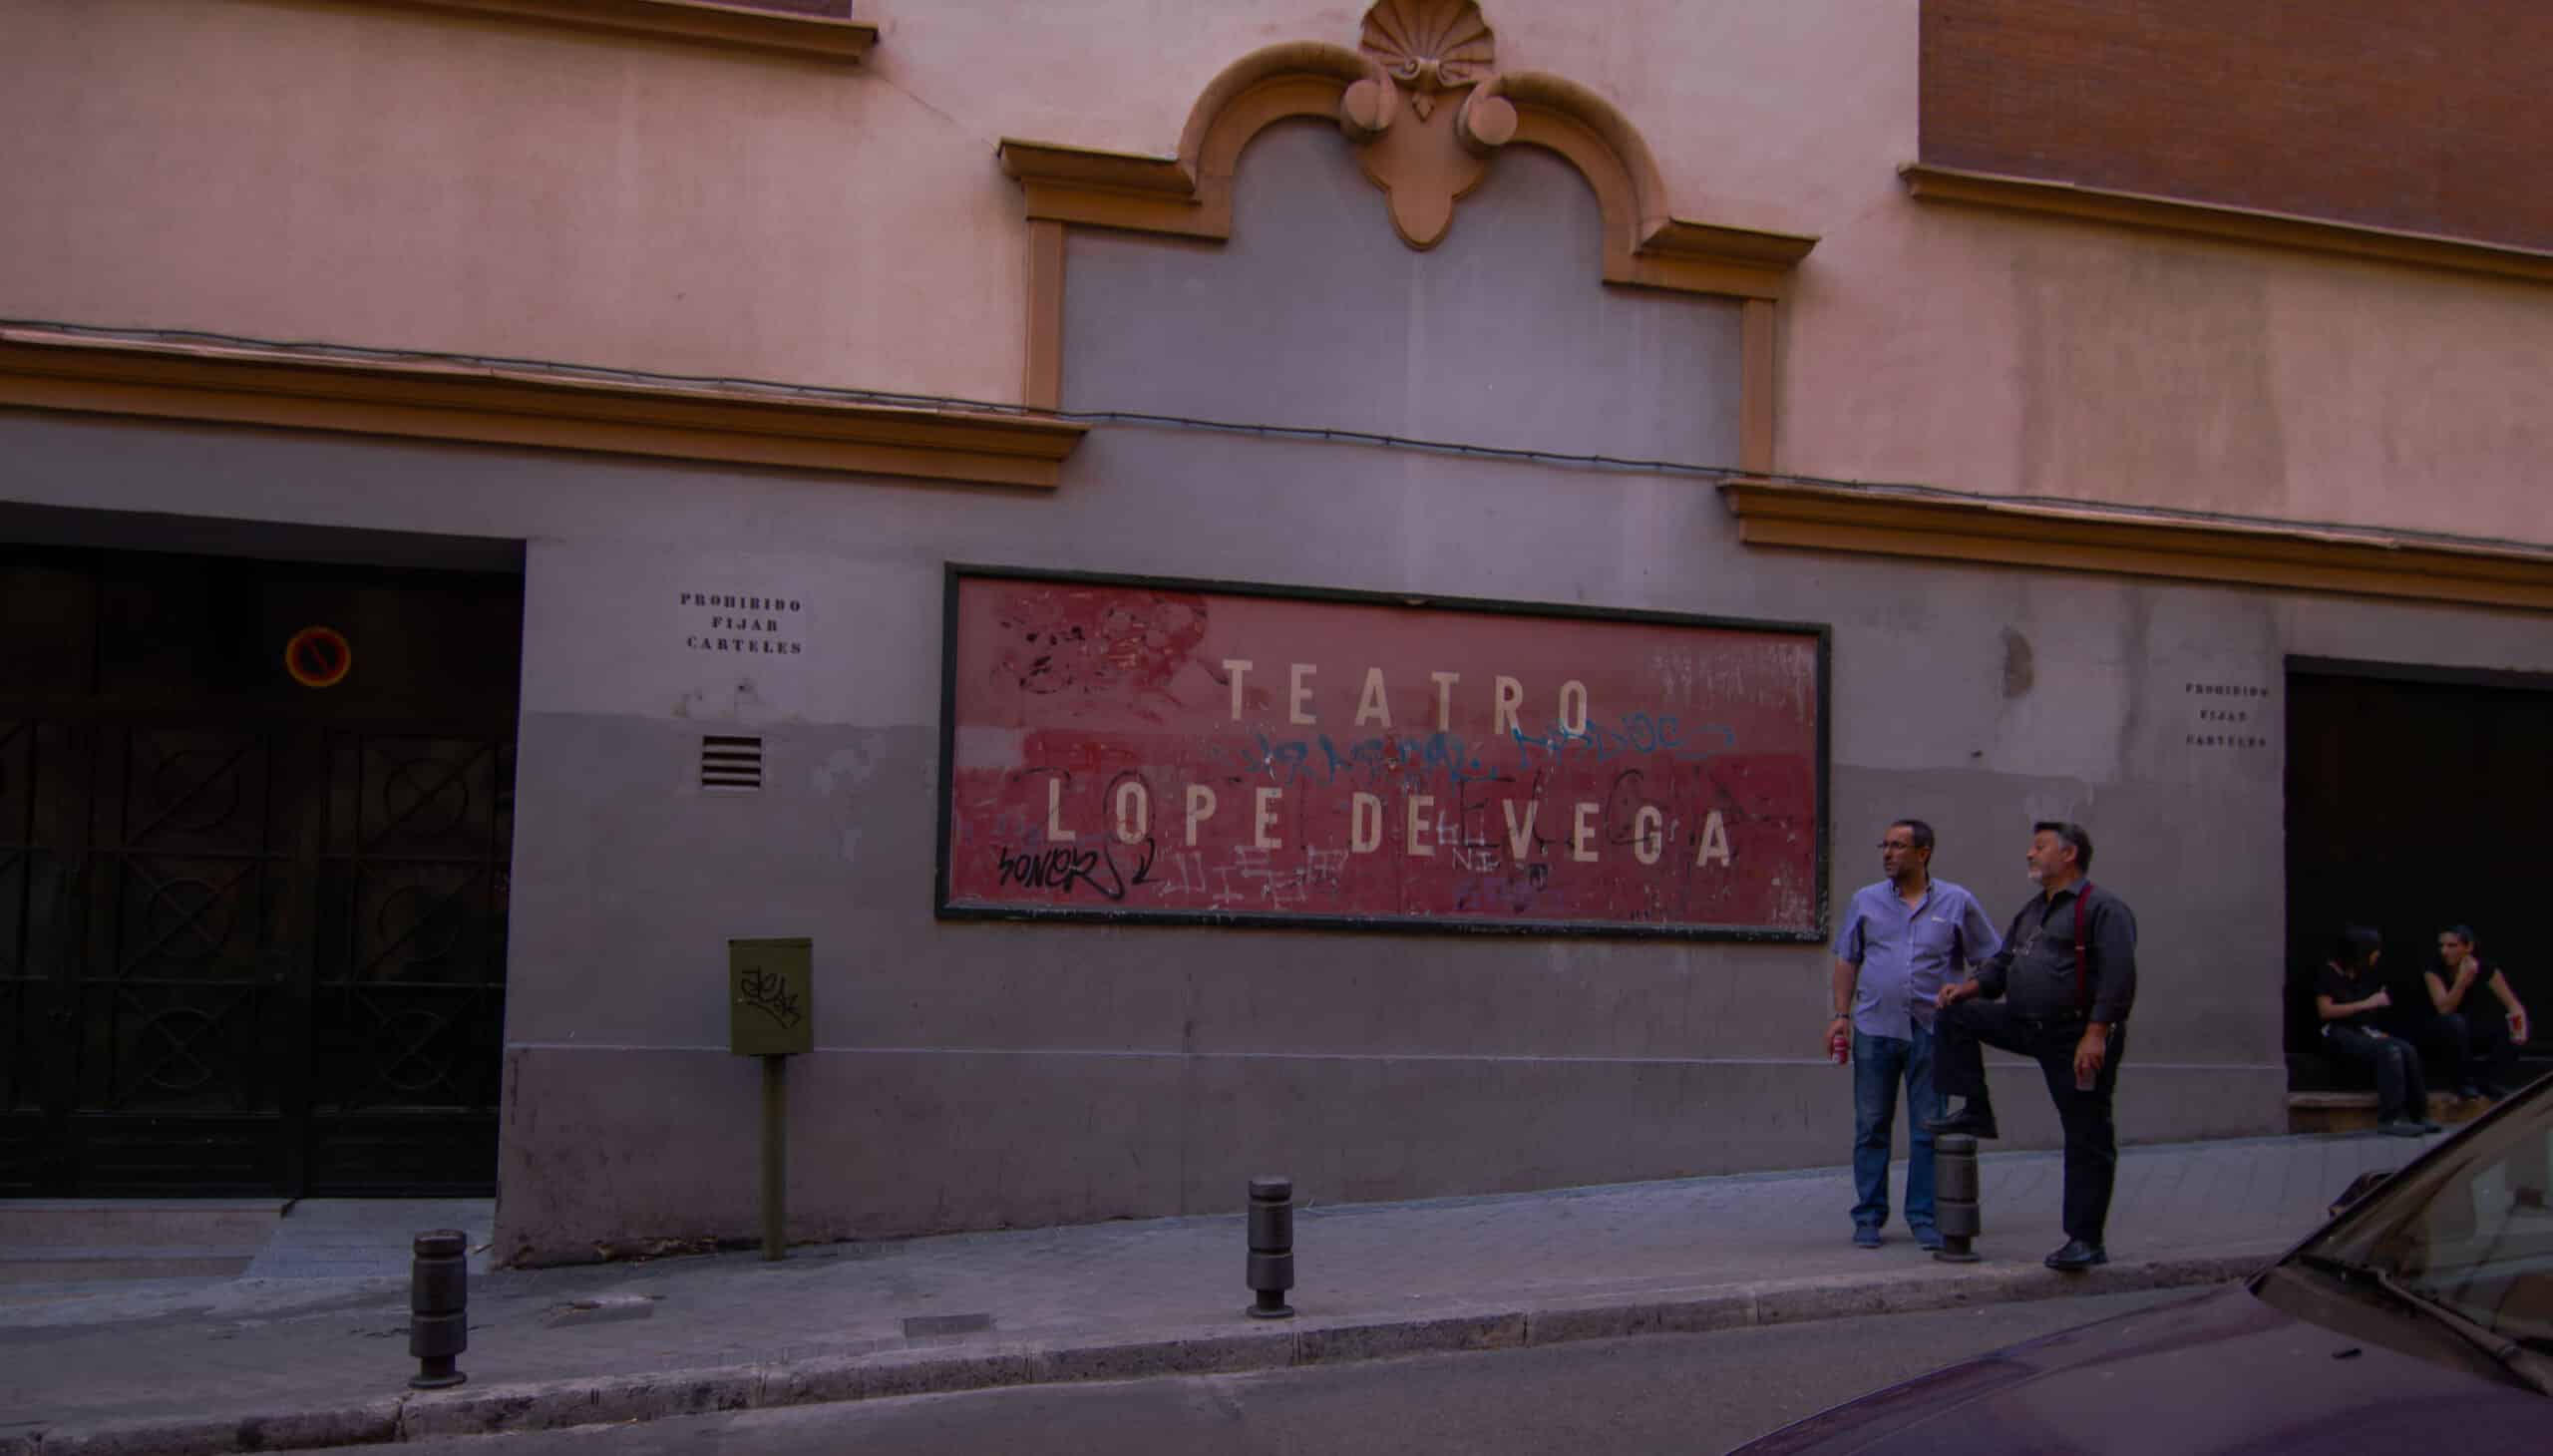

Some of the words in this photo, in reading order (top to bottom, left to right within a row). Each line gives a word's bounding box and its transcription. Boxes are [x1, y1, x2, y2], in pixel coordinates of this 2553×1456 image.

[680, 592, 801, 611] PROHIBIDO
[711, 616, 778, 632] FIJAR
[686, 635, 801, 654] CARTELES
[1223, 658, 1589, 739] TEATRO
[1047, 778, 1287, 850] LOPE
[1351, 792, 1436, 858] DE
[1502, 799, 1731, 868] VEGA
